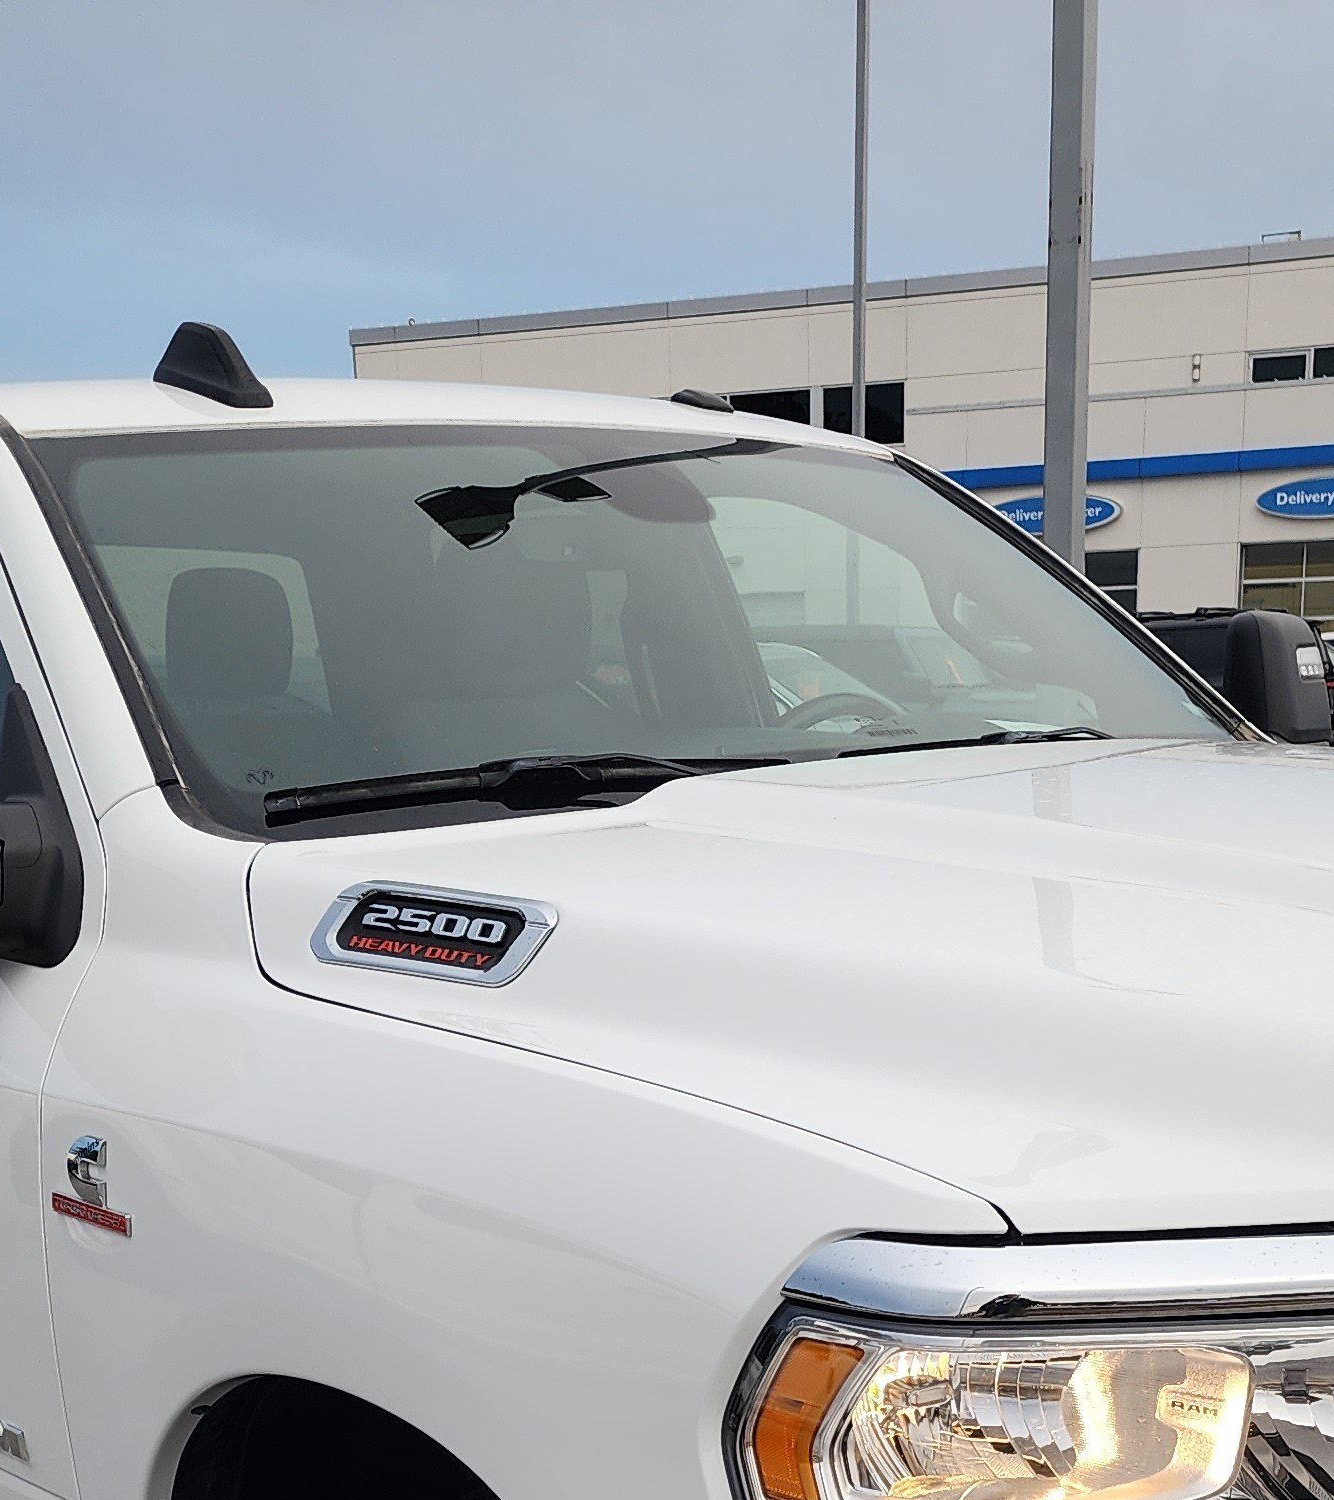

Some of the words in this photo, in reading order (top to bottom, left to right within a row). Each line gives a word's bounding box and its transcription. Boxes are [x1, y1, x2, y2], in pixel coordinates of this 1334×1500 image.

[1000, 507, 1043, 522] Deliver
[361, 903, 509, 944] 2500
[349, 934, 424, 956] HEAVY
[424, 946, 494, 967] DUTY
[1171, 1400, 1219, 1417] RAM
